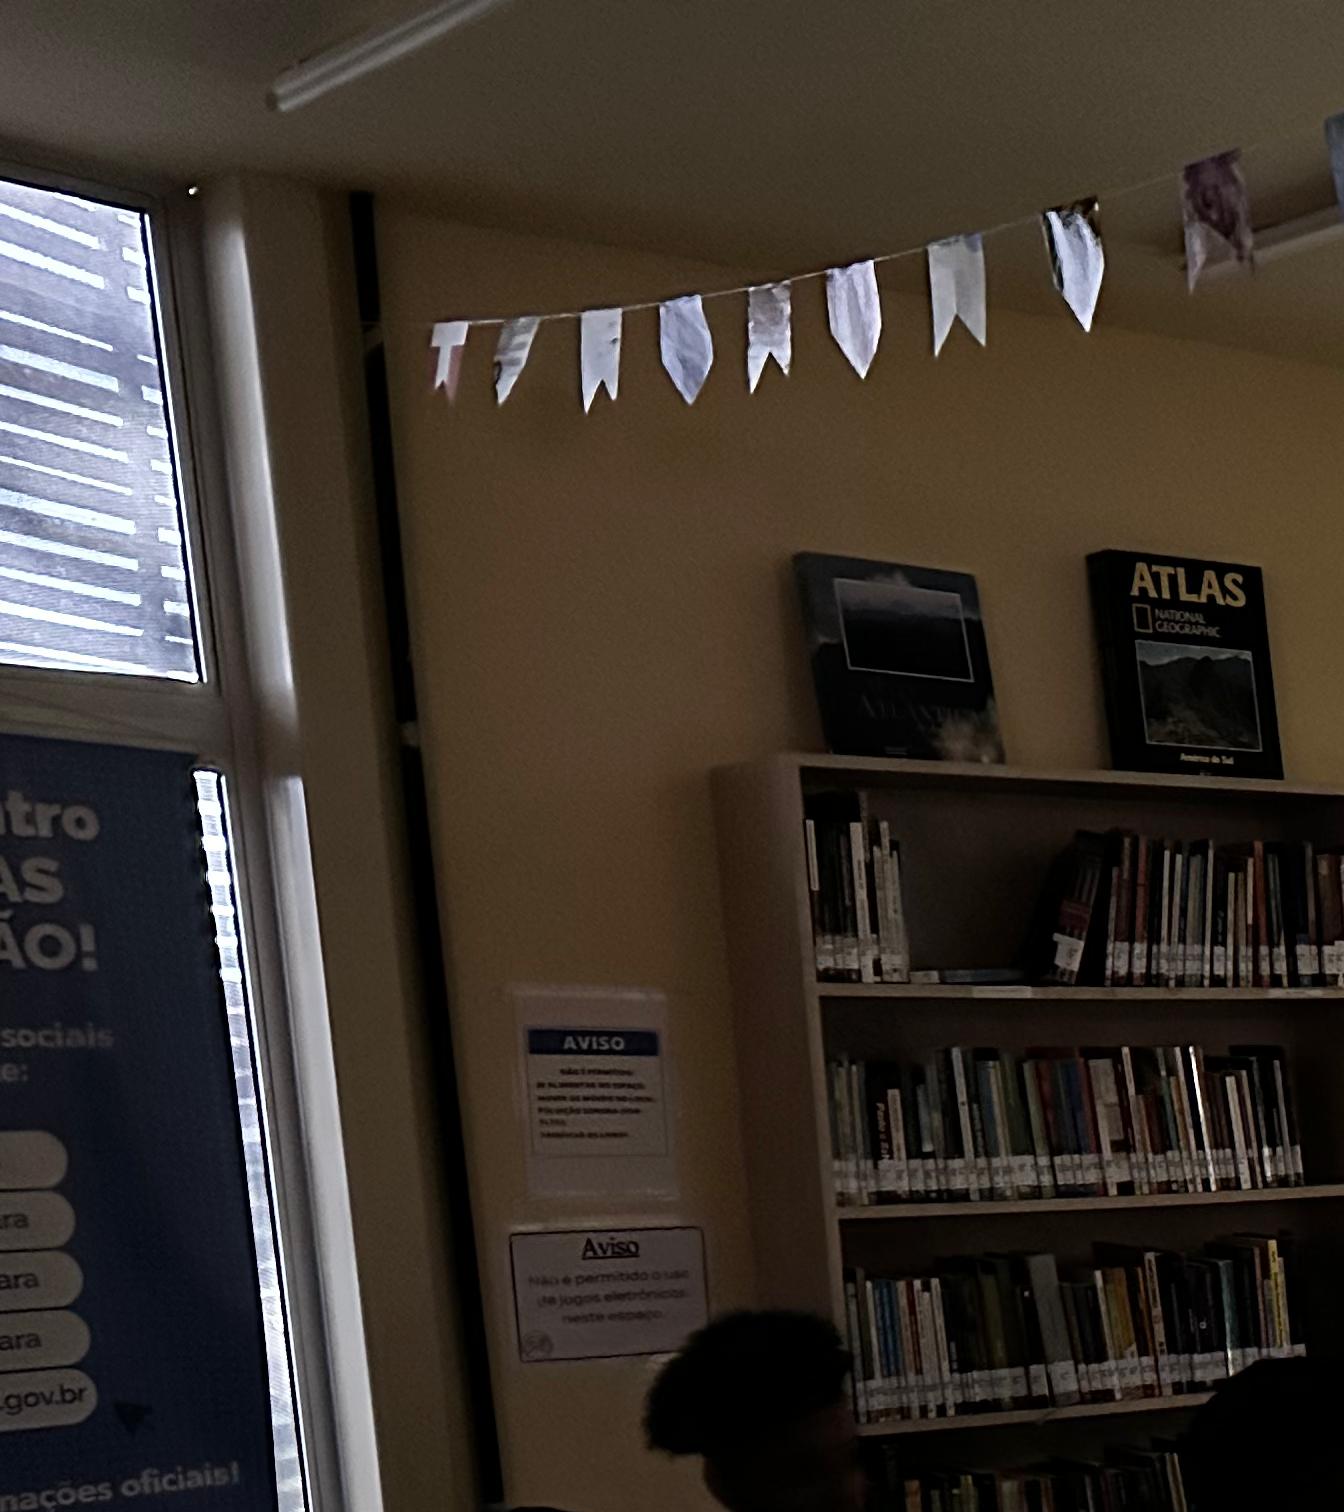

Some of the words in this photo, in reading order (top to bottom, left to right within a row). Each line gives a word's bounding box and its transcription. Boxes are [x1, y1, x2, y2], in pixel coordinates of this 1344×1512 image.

[1129, 561, 1247, 608] ATLAS
[1155, 609, 1206, 624] NATIONAL
[1155, 622, 1222, 638] GEOGRAPHIC
[0, 790, 100, 841] tro
[1, 1022, 114, 1049] sociais
[562, 1036, 626, 1051] AVISO
[582, 1237, 639, 1259] Aviso
[575, 1270, 649, 1287] permitido
[120, 1460, 241, 1498] oficiais!
